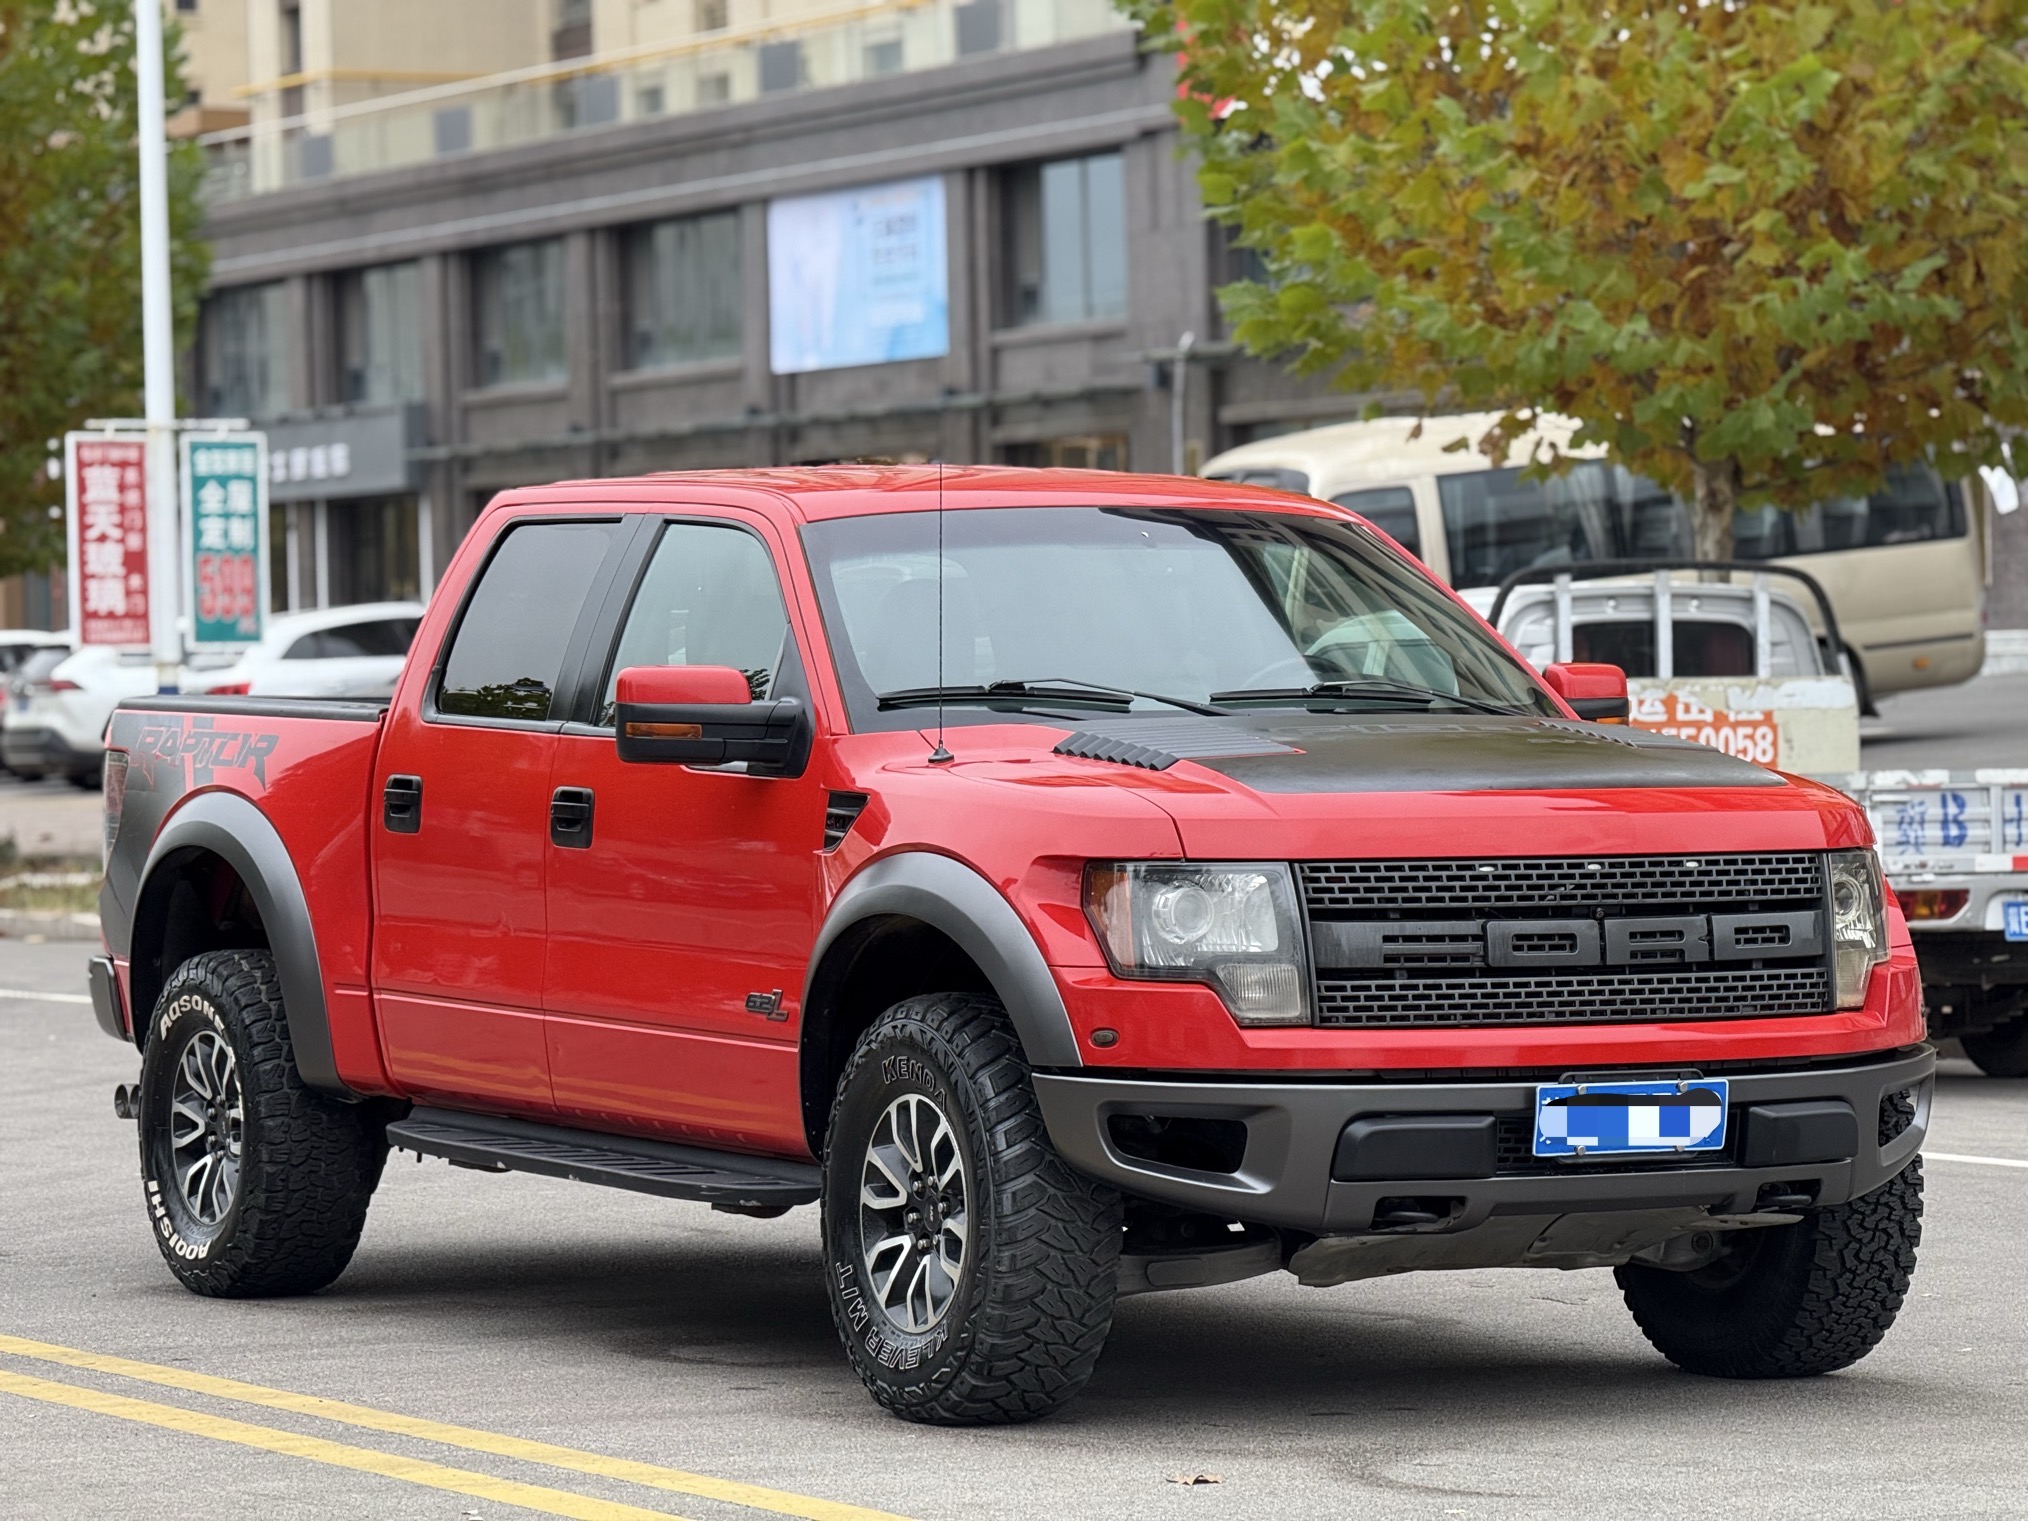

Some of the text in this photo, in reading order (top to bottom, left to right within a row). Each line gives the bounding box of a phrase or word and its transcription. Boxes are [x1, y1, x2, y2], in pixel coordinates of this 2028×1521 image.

[1310, 911, 1825, 968] FORD
[881, 1055, 947, 1112] KENDA
[864, 1319, 950, 1370] KLEVER
